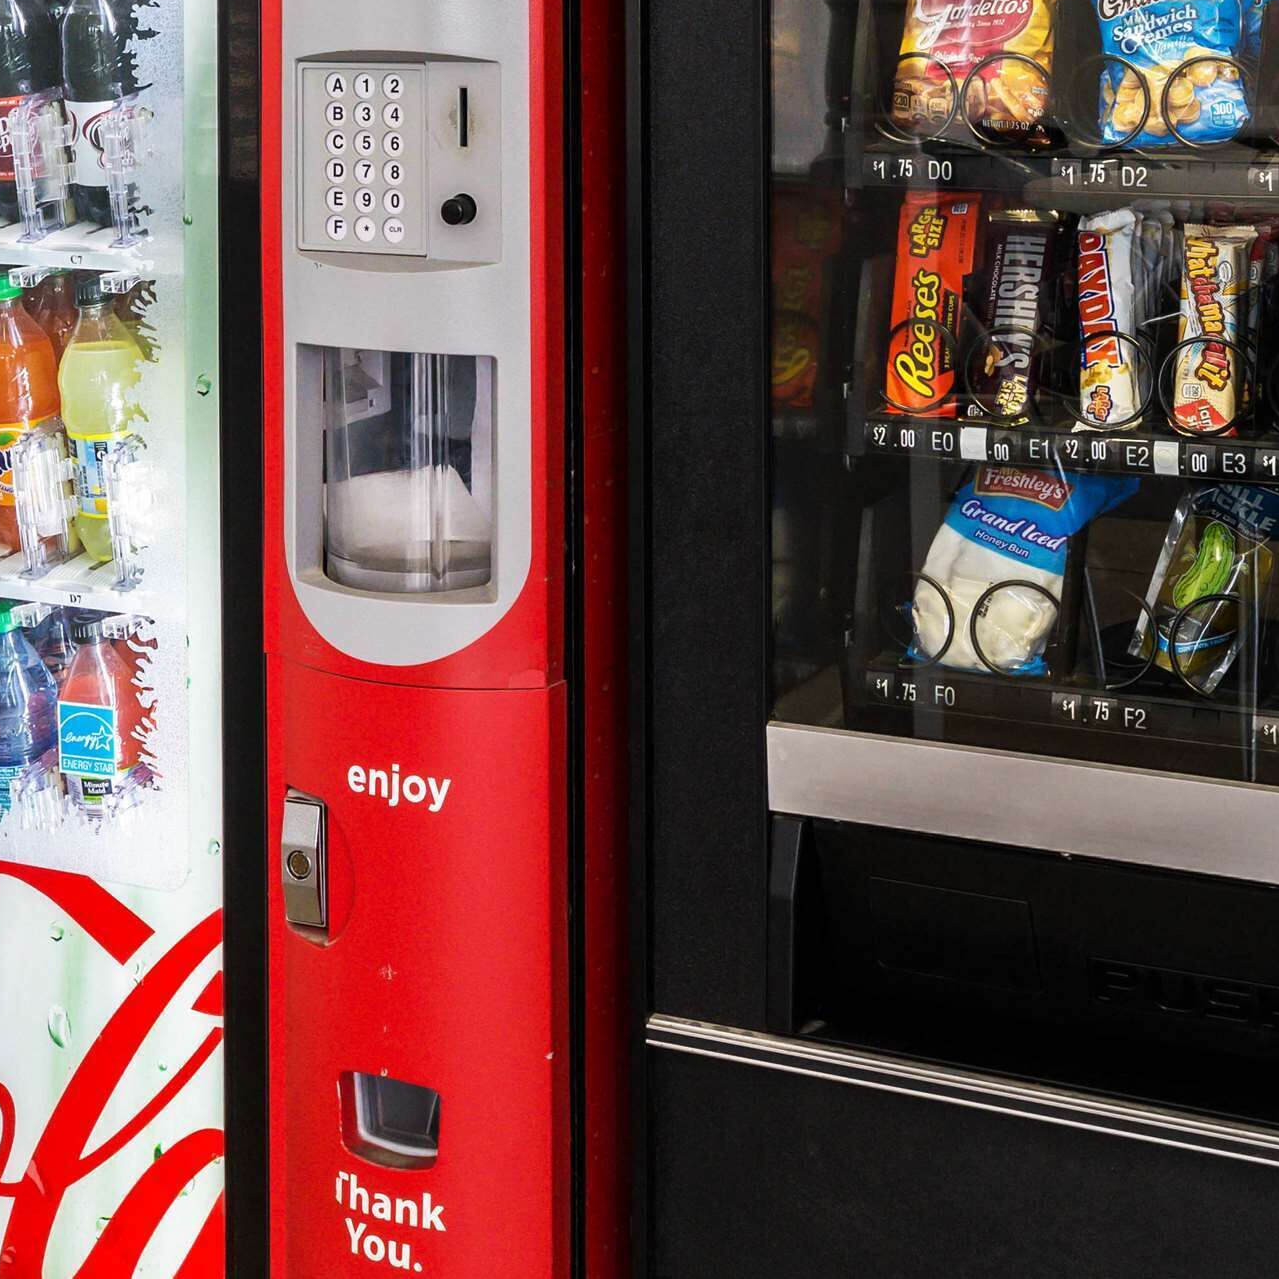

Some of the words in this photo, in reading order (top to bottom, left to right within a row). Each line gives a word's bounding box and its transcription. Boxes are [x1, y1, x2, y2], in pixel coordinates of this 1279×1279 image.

[1113, 4, 1197, 42] Sandwich
[1120, 20, 1193, 55] Cremes
[333, 78, 343, 92] A
[363, 79, 368, 92] 1
[391, 79, 398, 93] 2
[928, 162, 952, 180] D0
[911, 207, 937, 256] LARGE
[927, 216, 945, 248] SIZE
[71, 256, 82, 264] C7
[895, 270, 941, 397] Reese's
[932, 431, 953, 451] E0
[985, 467, 1066, 499] Freshley's
[960, 499, 1020, 534] Grand
[1021, 522, 1069, 552] Iced
[975, 529, 1008, 553] Honey
[1008, 540, 1029, 558] Bun
[69, 595, 81, 604] D7
[63, 758, 93, 770] ENERGY
[94, 760, 113, 773] STAR
[348, 763, 451, 813] enjoy
[336, 1170, 447, 1232] Thank
[345, 1218, 423, 1272] You.
